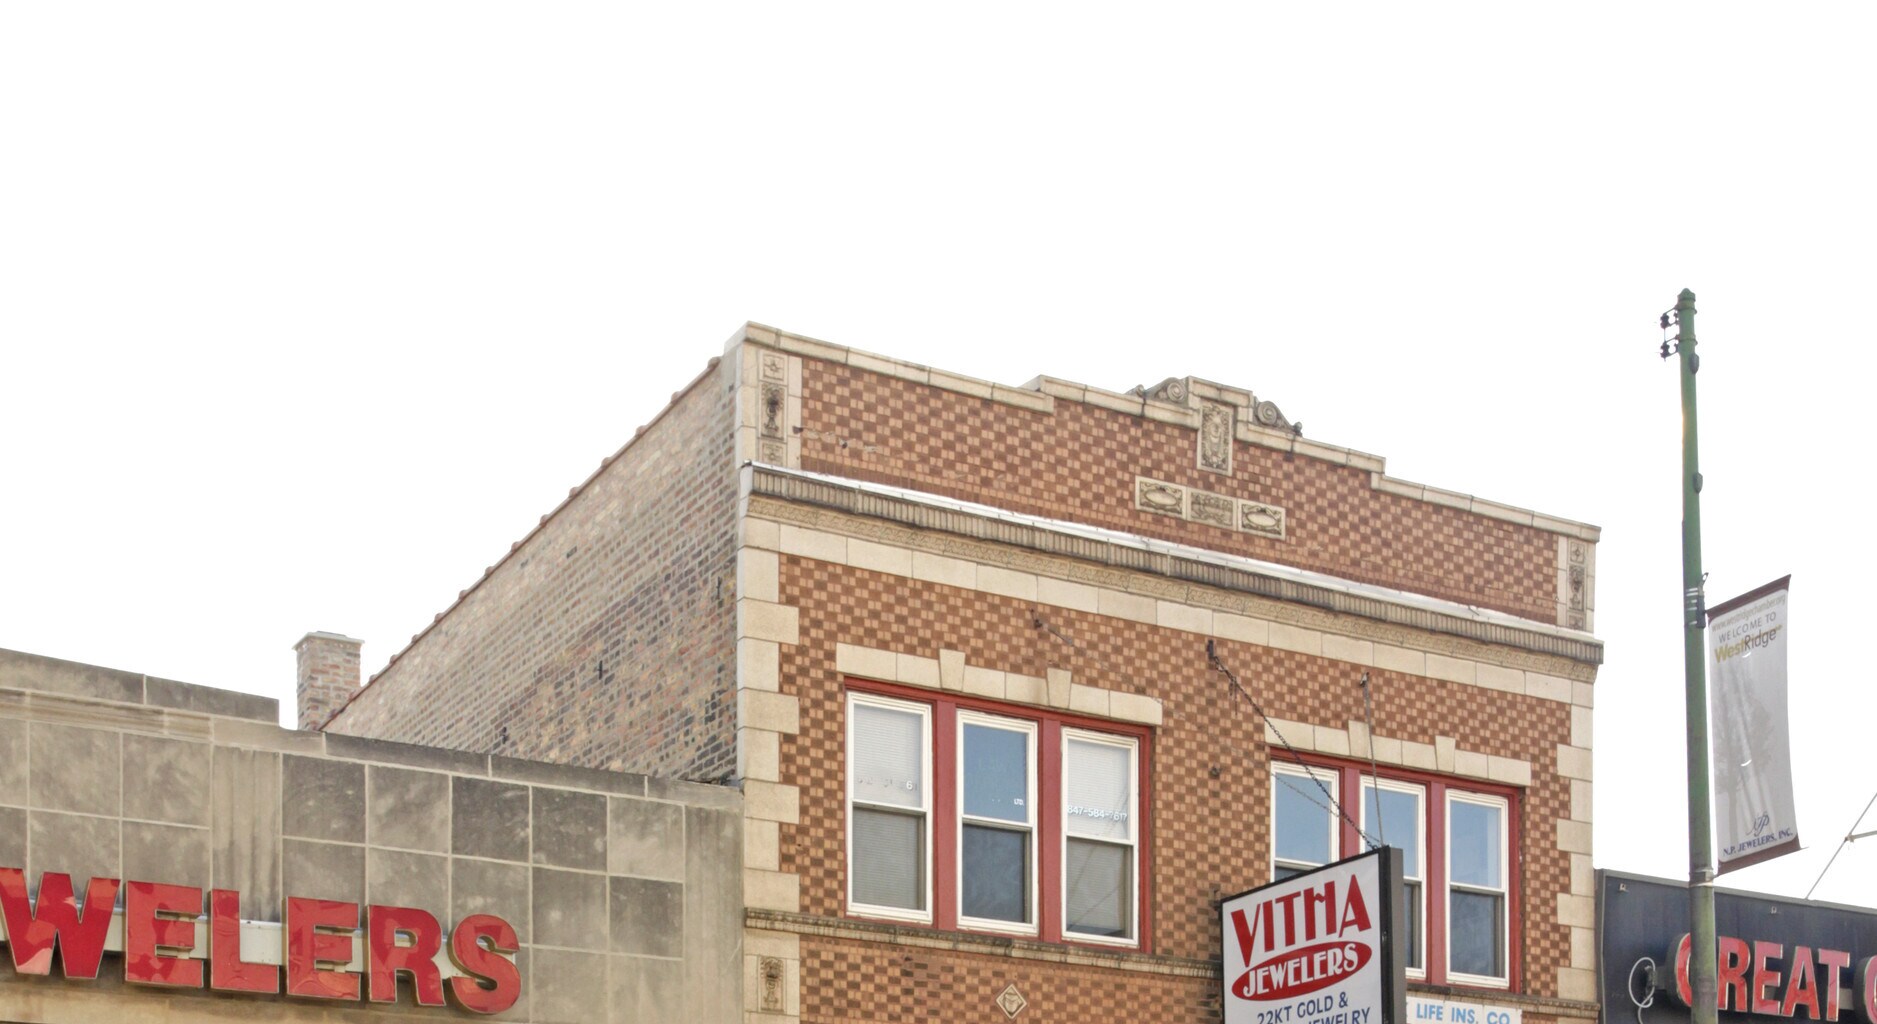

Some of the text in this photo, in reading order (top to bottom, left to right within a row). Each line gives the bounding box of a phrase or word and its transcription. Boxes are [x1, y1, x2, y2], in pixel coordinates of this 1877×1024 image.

[1719, 611, 1776, 643] WELCOME TO
[1714, 629, 1777, 664] WestRidge
[1231, 874, 1371, 968] VITHA
[0, 867, 521, 1014] WELERS
[1243, 943, 1358, 997] JEWELERS
[1297, 994, 1333, 1019] GOLD
[1339, 991, 1348, 1007] &
[1416, 1003, 1443, 1022] LIFE
[1451, 1007, 1479, 1024] INS.
